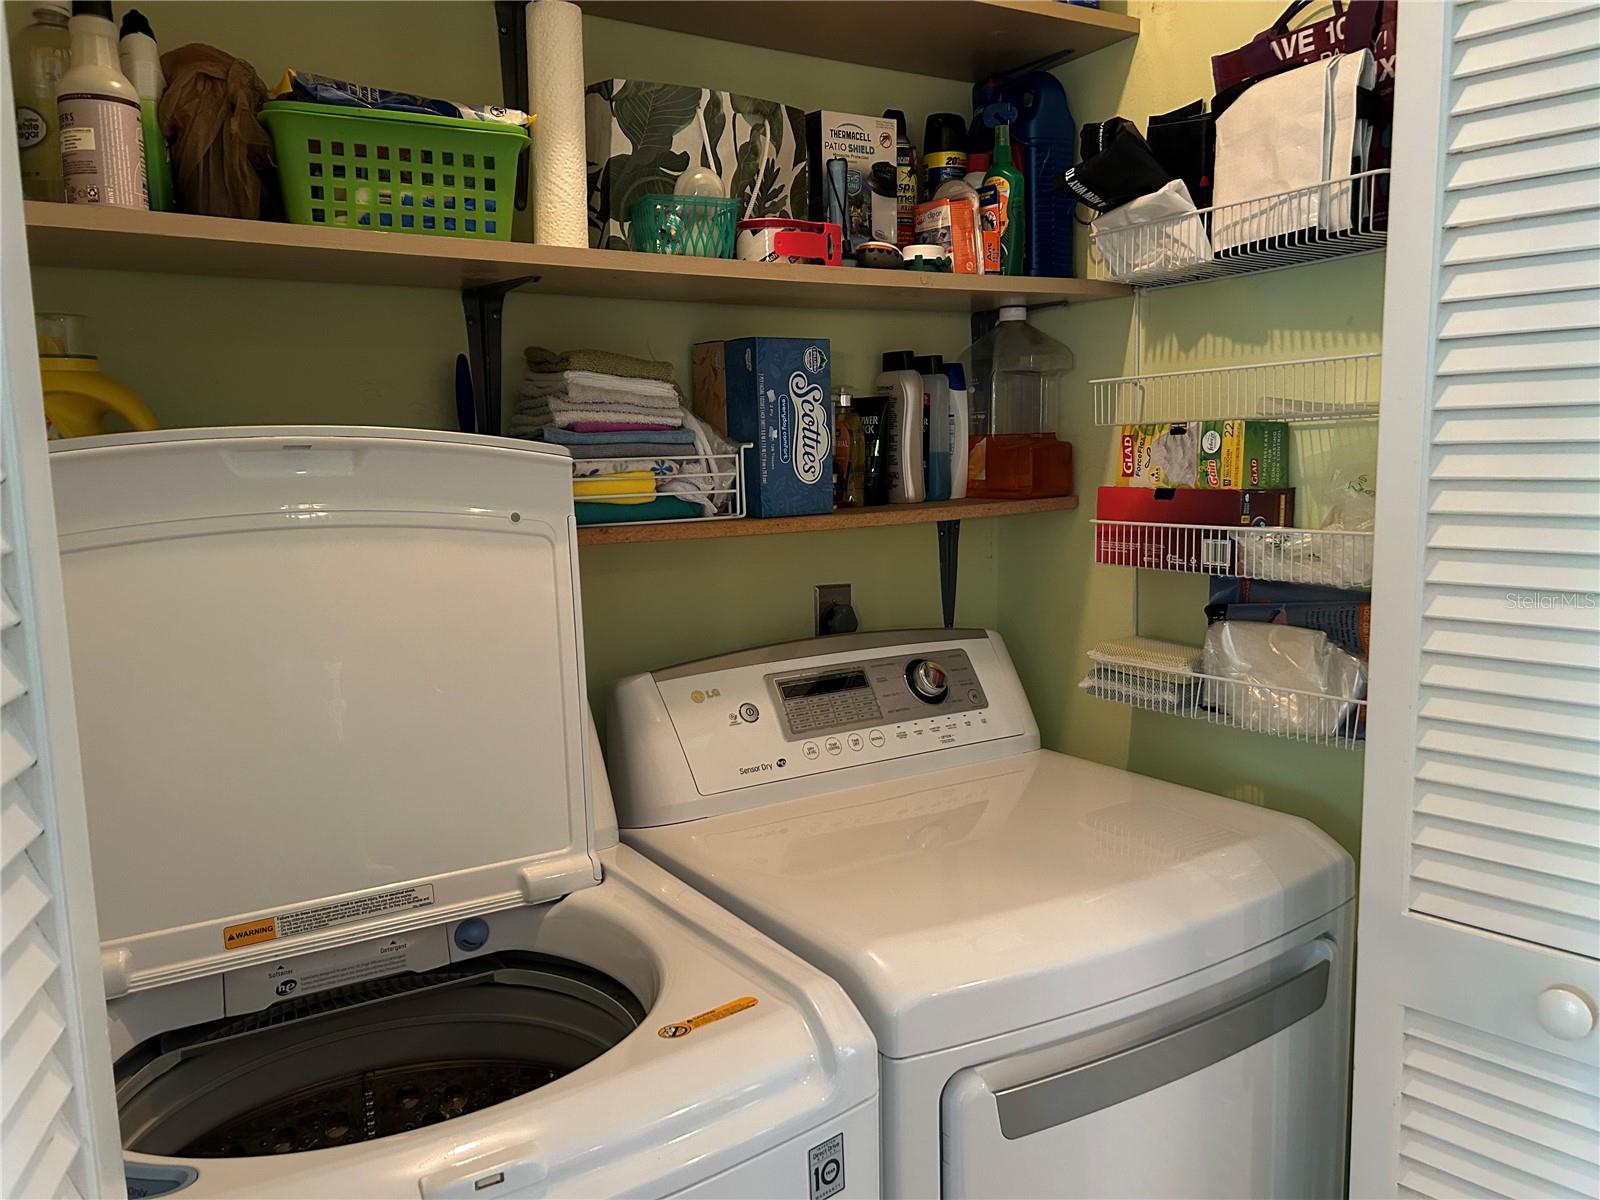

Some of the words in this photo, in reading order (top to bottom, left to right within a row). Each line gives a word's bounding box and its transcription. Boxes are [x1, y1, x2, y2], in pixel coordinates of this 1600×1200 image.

[829, 128, 872, 143] THERMACELL
[824, 141, 847, 152] PATIO
[848, 143, 875, 155] SHIELD
[1064, 167, 1076, 182] TO
[781, 398, 789, 431] everyday
[791, 373, 822, 475] Scotties
[1224, 422, 1235, 438] 22
[1123, 436, 1133, 474] GLAD
[1135, 435, 1146, 477] ForceFlex
[1206, 460, 1219, 487] Gain
[1251, 459, 1259, 485] GLAD
[705, 688, 721, 699] LG
[739, 763, 760, 776] Sensor
[760, 761, 773, 773] Dry
[235, 924, 274, 940] WARNING
[379, 942, 407, 955] Detergent
[812, 1147, 827, 1160] Direct
[827, 1142, 840, 1152] Drive
[814, 1158, 840, 1192] 10
